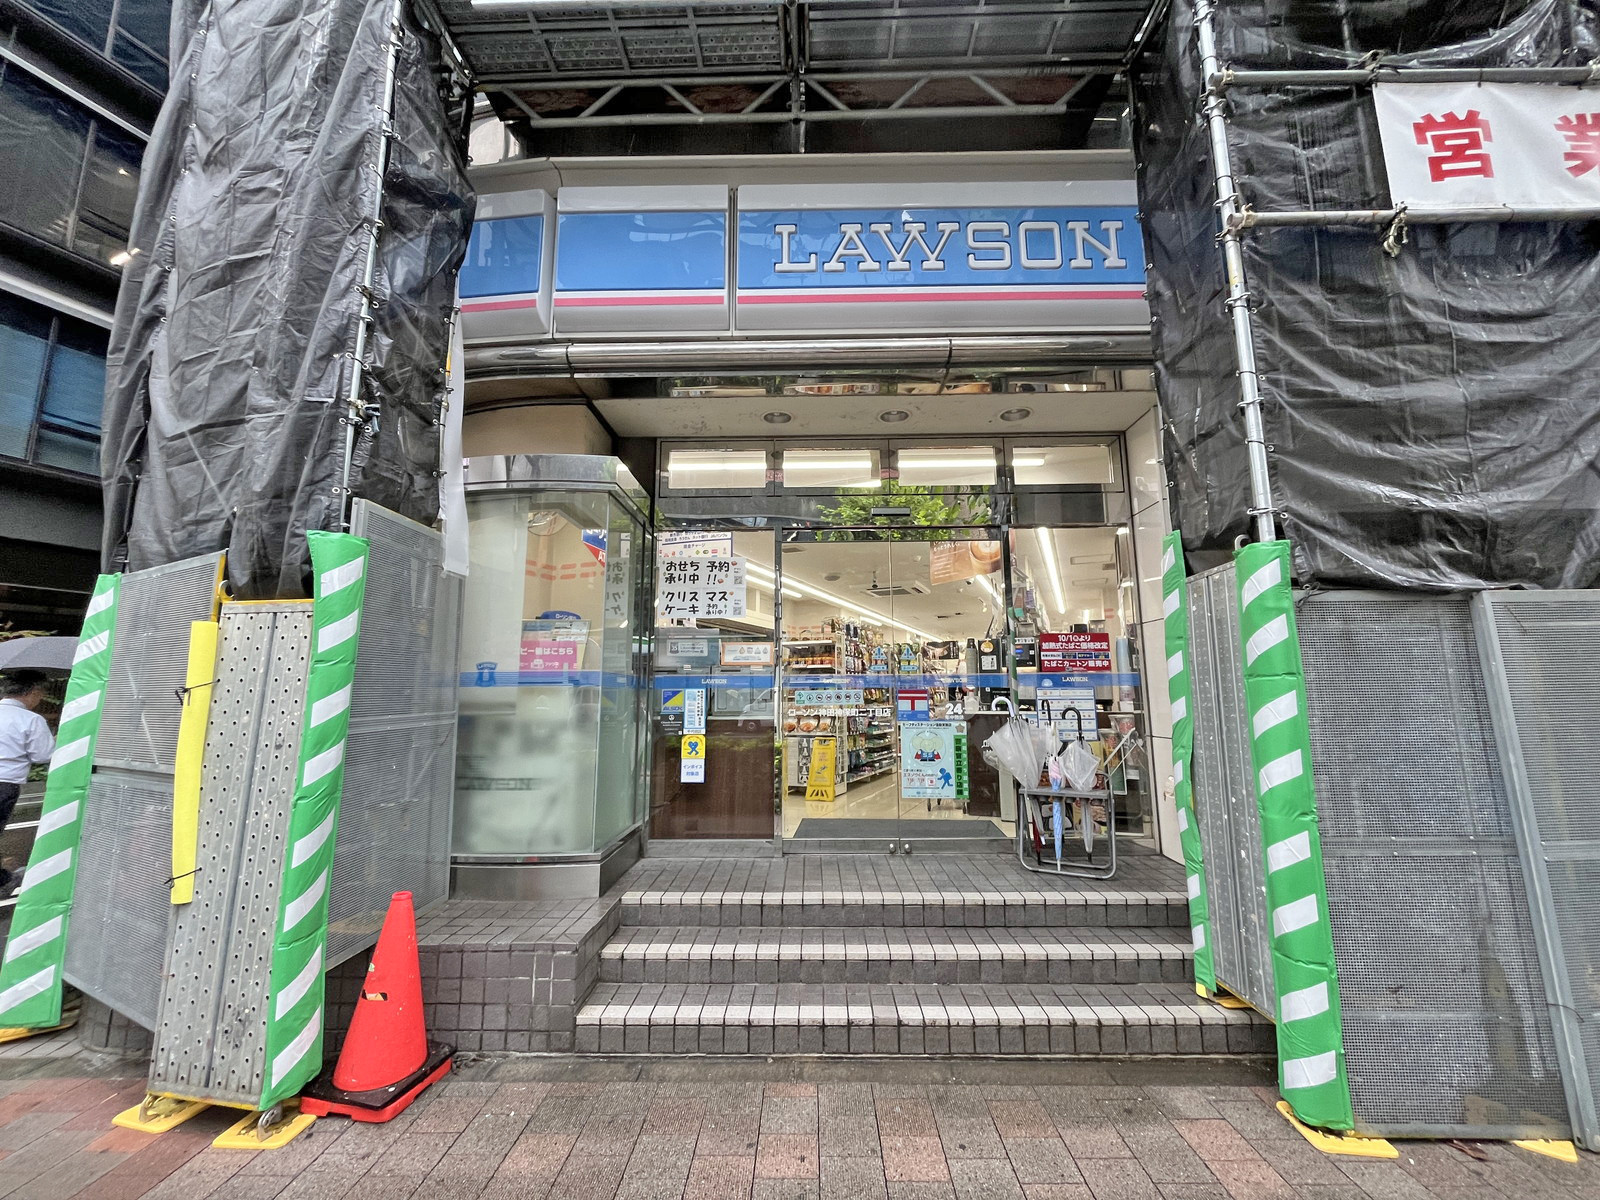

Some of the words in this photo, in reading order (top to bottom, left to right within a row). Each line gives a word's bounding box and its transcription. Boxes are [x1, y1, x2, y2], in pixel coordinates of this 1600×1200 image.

[1413, 109, 1600, 183] 営業
[773, 220, 1127, 273] LAWSON
[664, 604, 699, 614] ケーキ
[520, 647, 574, 656] ピー機はこちら
[945, 703, 963, 715] 24
